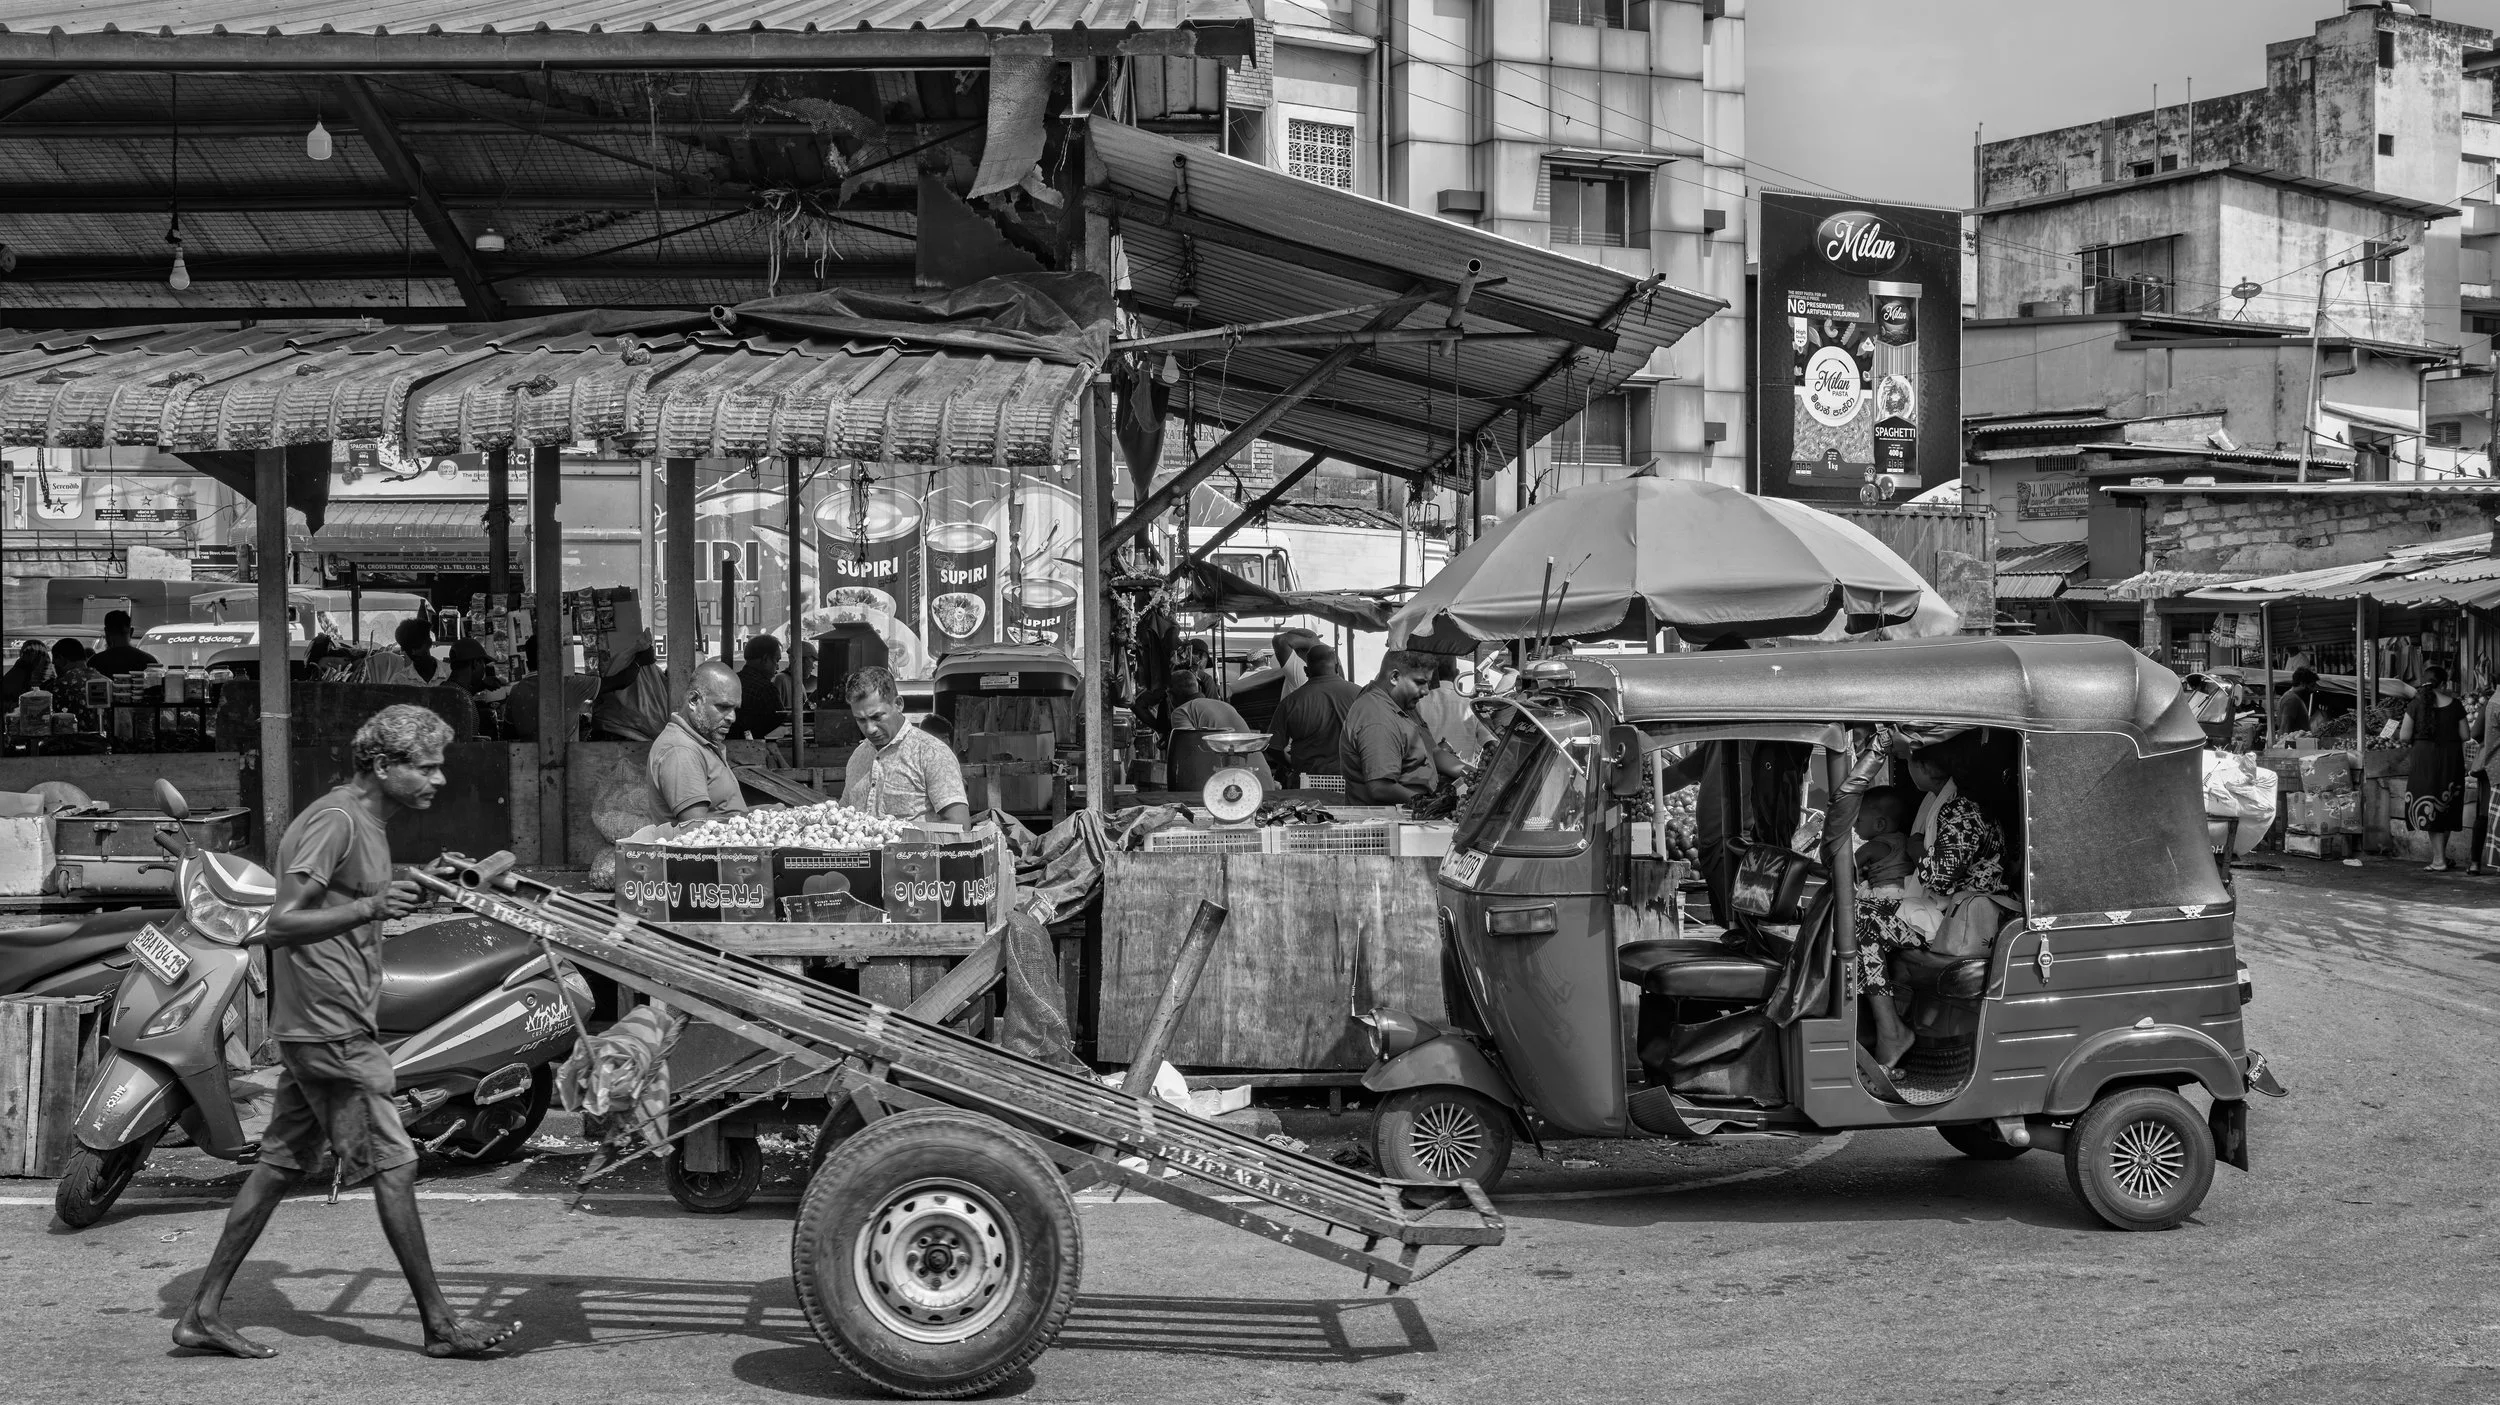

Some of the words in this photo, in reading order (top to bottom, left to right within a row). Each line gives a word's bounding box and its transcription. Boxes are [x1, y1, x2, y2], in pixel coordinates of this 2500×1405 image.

[1826, 219, 1896, 262] Milan
[1787, 299, 1807, 314] NO
[1806, 302, 1845, 311] PRESERVATIVES
[1883, 306, 1907, 321] Milan
[1814, 370, 1851, 392] Milan
[1875, 427, 1916, 438] SPAGHETTI
[52, 482, 79, 491] Serendib
[386, 563, 409, 571] STREET,
[837, 556, 898, 578] SUPIRI
[940, 563, 988, 585] SUPIRI
[1018, 615, 1061, 628] UPIRI
[1010, 676, 1017, 684] P
[624, 880, 683, 908] Apple
[689, 882, 765, 909] FRESH
[894, 880, 956, 907] Apple
